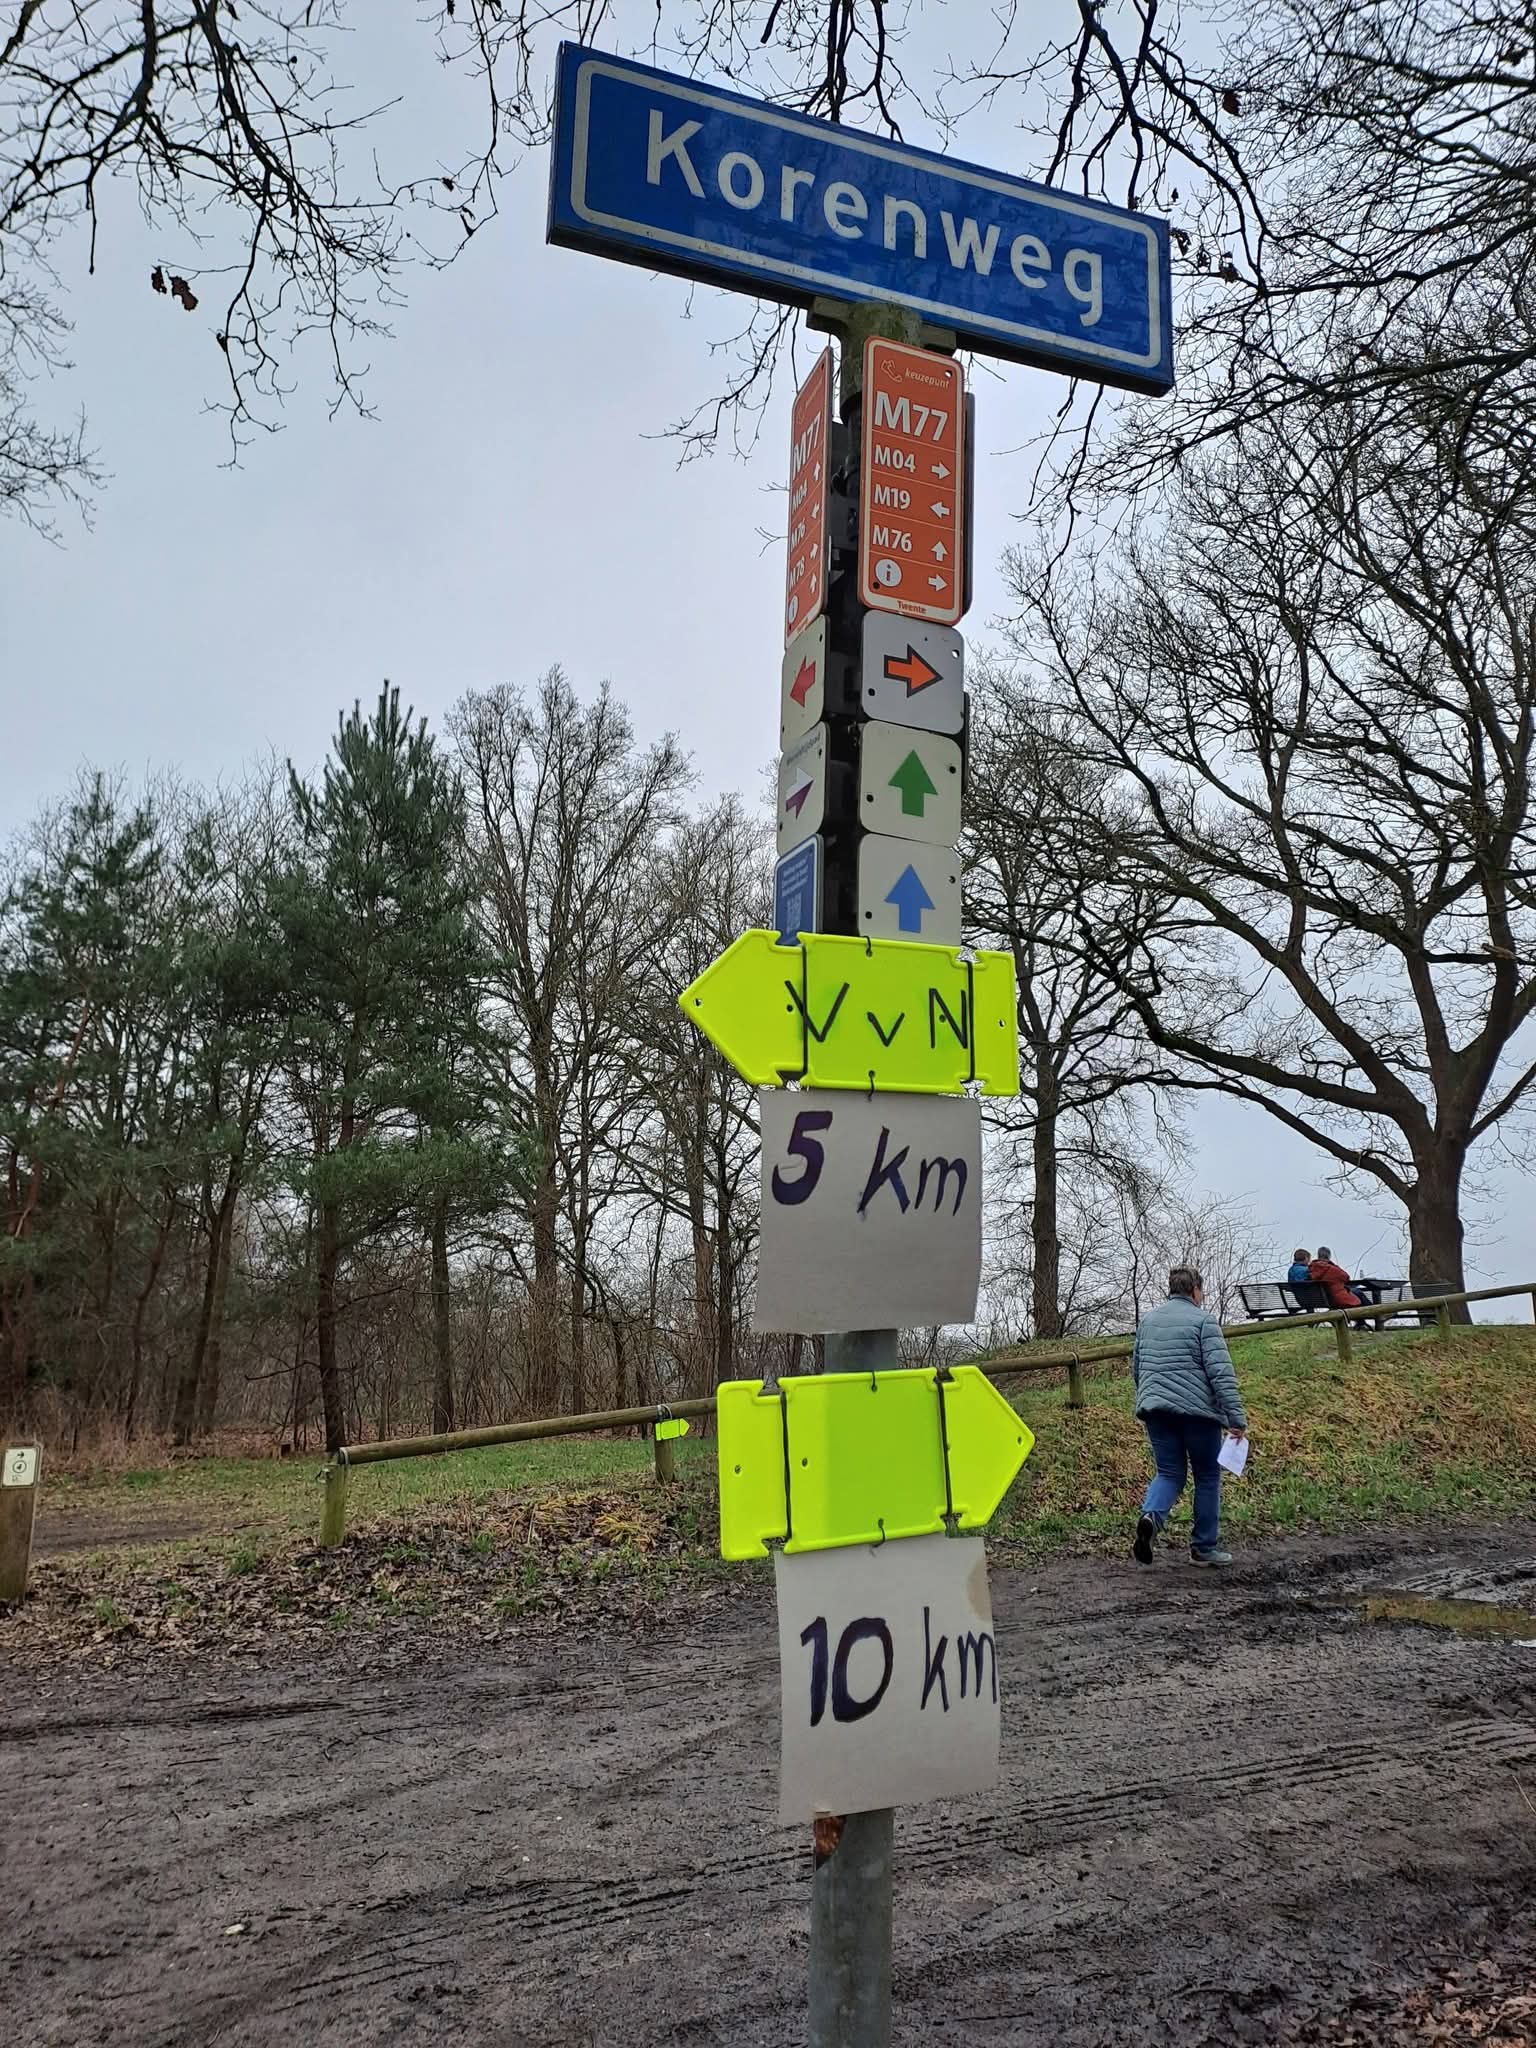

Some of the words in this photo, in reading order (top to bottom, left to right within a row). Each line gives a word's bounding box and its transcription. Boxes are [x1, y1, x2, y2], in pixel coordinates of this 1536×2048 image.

[646, 109, 1103, 327] Korenweg
[905, 368, 950, 389] keuzepunt
[874, 391, 948, 441] M77
[793, 411, 821, 477] M77
[874, 444, 916, 473] M04
[874, 483, 911, 510] M19
[872, 525, 912, 553] M76
[897, 600, 927, 614] Twente
[772, 1111, 833, 1206] 5
[857, 1125, 968, 1217] km
[800, 1615, 894, 1727] 10
[920, 1606, 997, 1713] km
